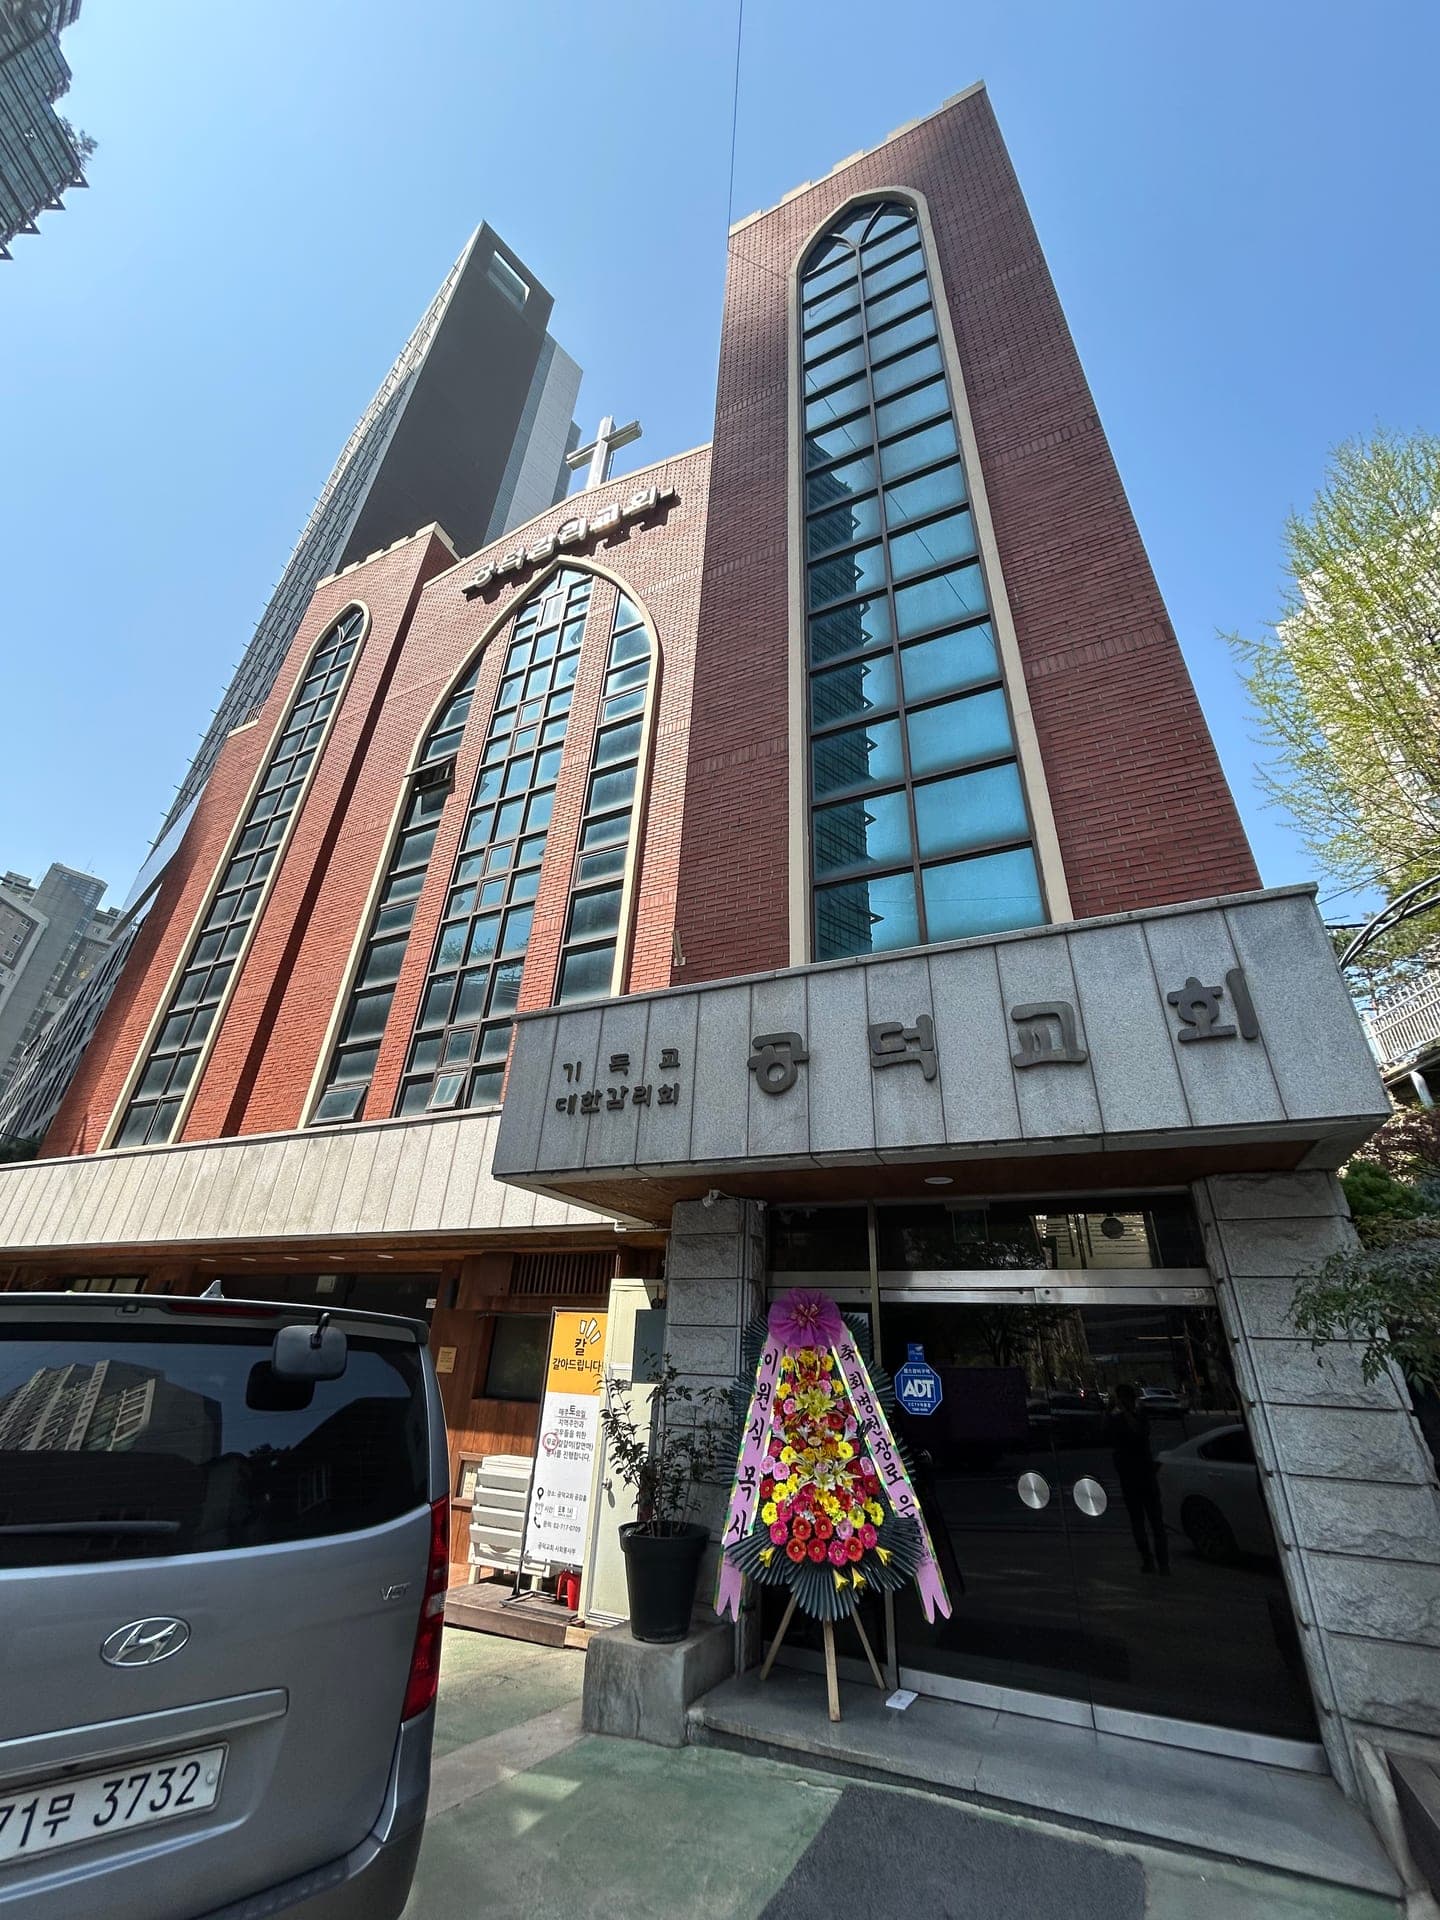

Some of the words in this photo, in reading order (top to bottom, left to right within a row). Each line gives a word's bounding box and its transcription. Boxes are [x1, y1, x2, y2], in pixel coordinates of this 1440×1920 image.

[472, 485, 662, 588] 공덕감리교회
[747, 967, 1260, 1096] 공덕교회
[563, 1047, 681, 1083] 기독교
[555, 1082, 680, 1115] 대한감리회
[575, 1338, 588, 1356] 칼
[839, 1344, 855, 1363] 축
[903, 1379, 934, 1398] ADT
[93, 1760, 202, 1827] 3732
